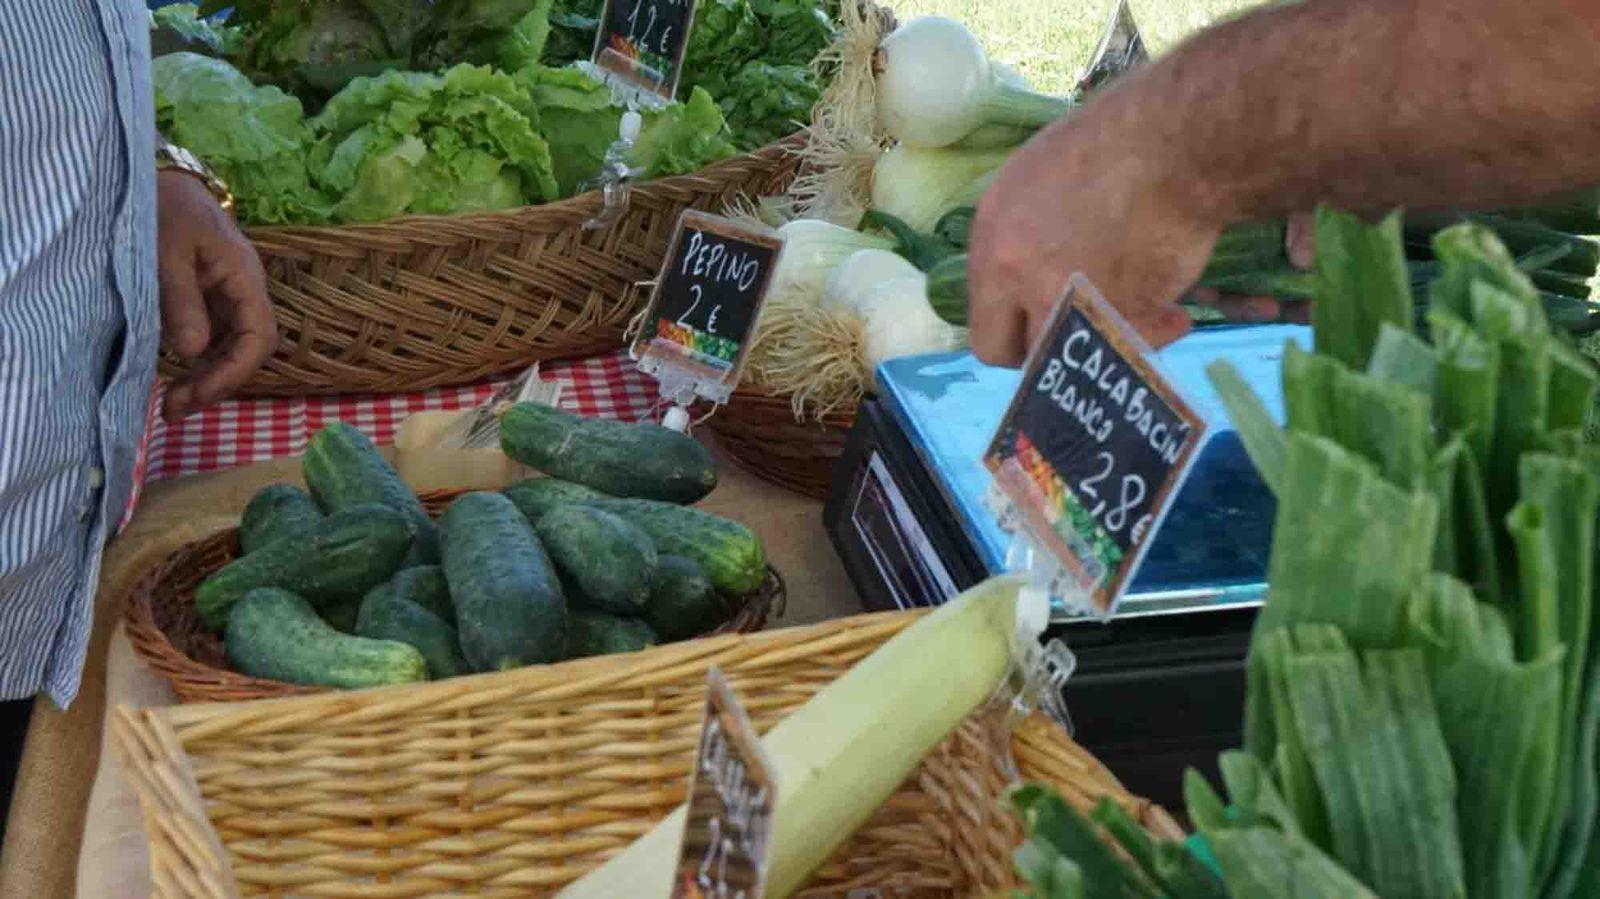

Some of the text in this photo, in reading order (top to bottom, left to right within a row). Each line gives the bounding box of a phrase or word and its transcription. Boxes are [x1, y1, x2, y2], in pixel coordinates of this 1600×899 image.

[660, 25, 672, 53] €
[682, 231, 759, 292] PEPINO
[677, 285, 722, 333] 2 €
[1037, 358, 1113, 441] BLANCO
[1079, 452, 1152, 545] 2,8 €
